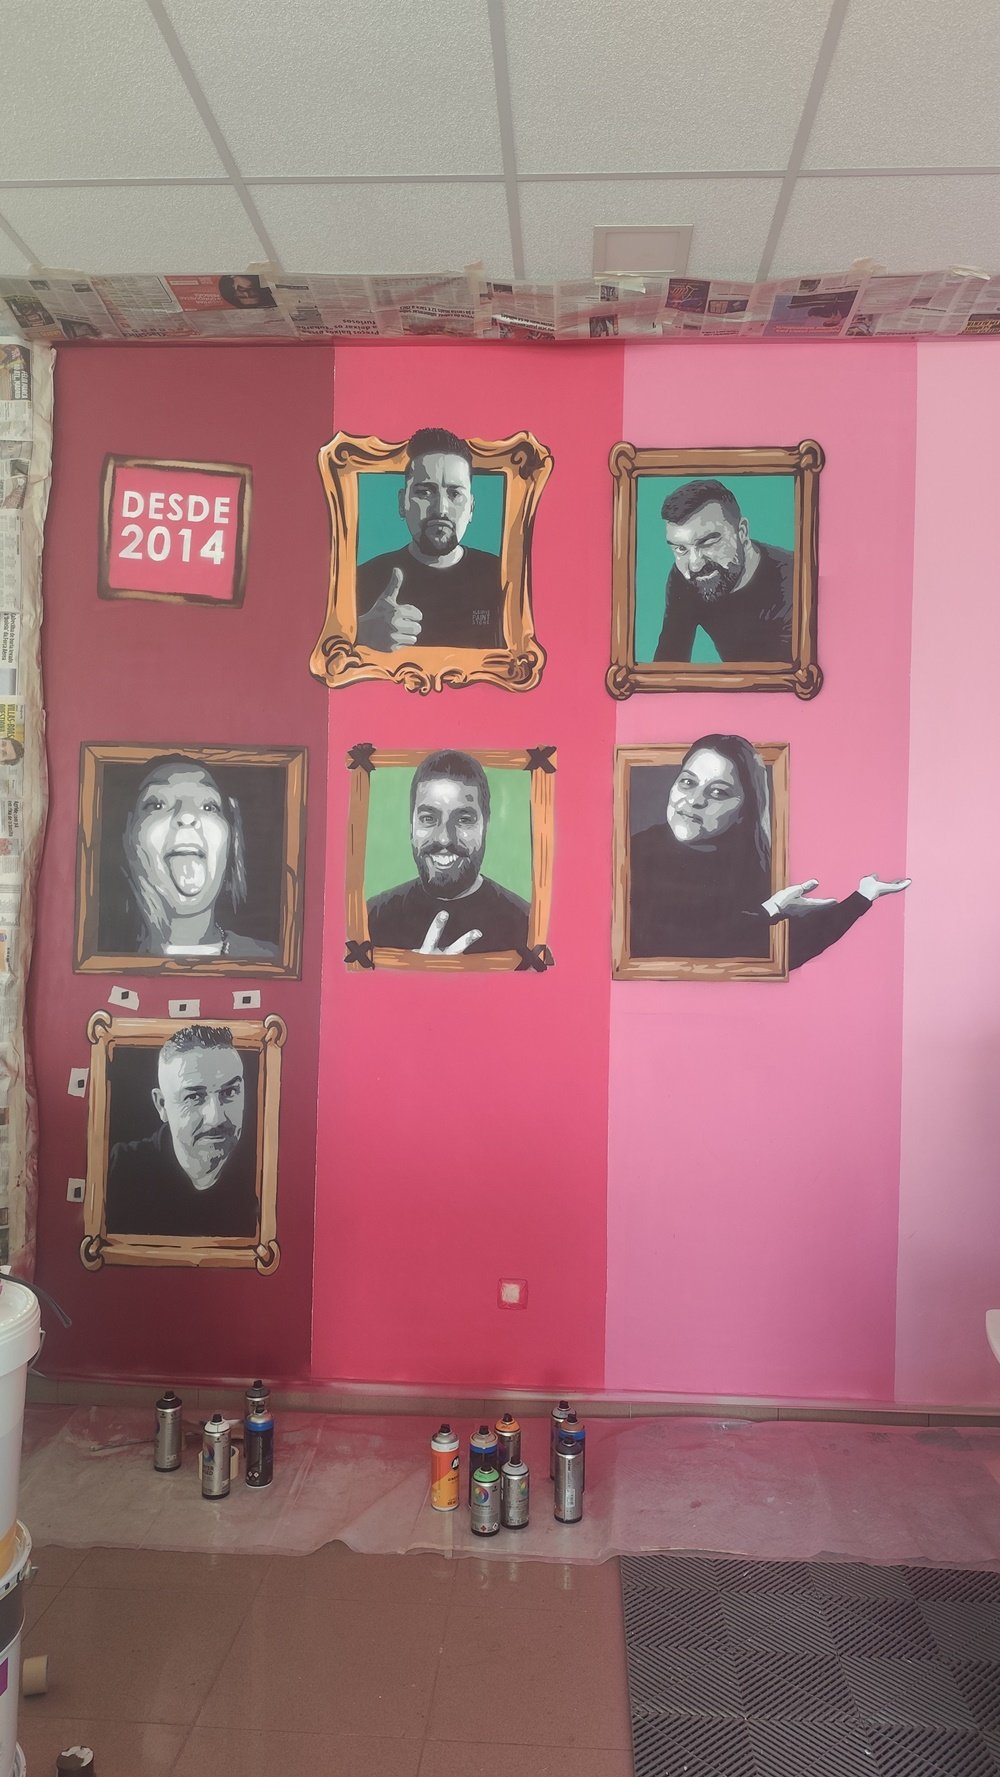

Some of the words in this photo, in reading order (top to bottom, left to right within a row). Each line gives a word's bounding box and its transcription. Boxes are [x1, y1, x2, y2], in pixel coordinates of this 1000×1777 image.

[121, 490, 231, 524] DESDE
[118, 523, 225, 565] 2014
[7, 704, 16, 738] VILLAS-BOAS
